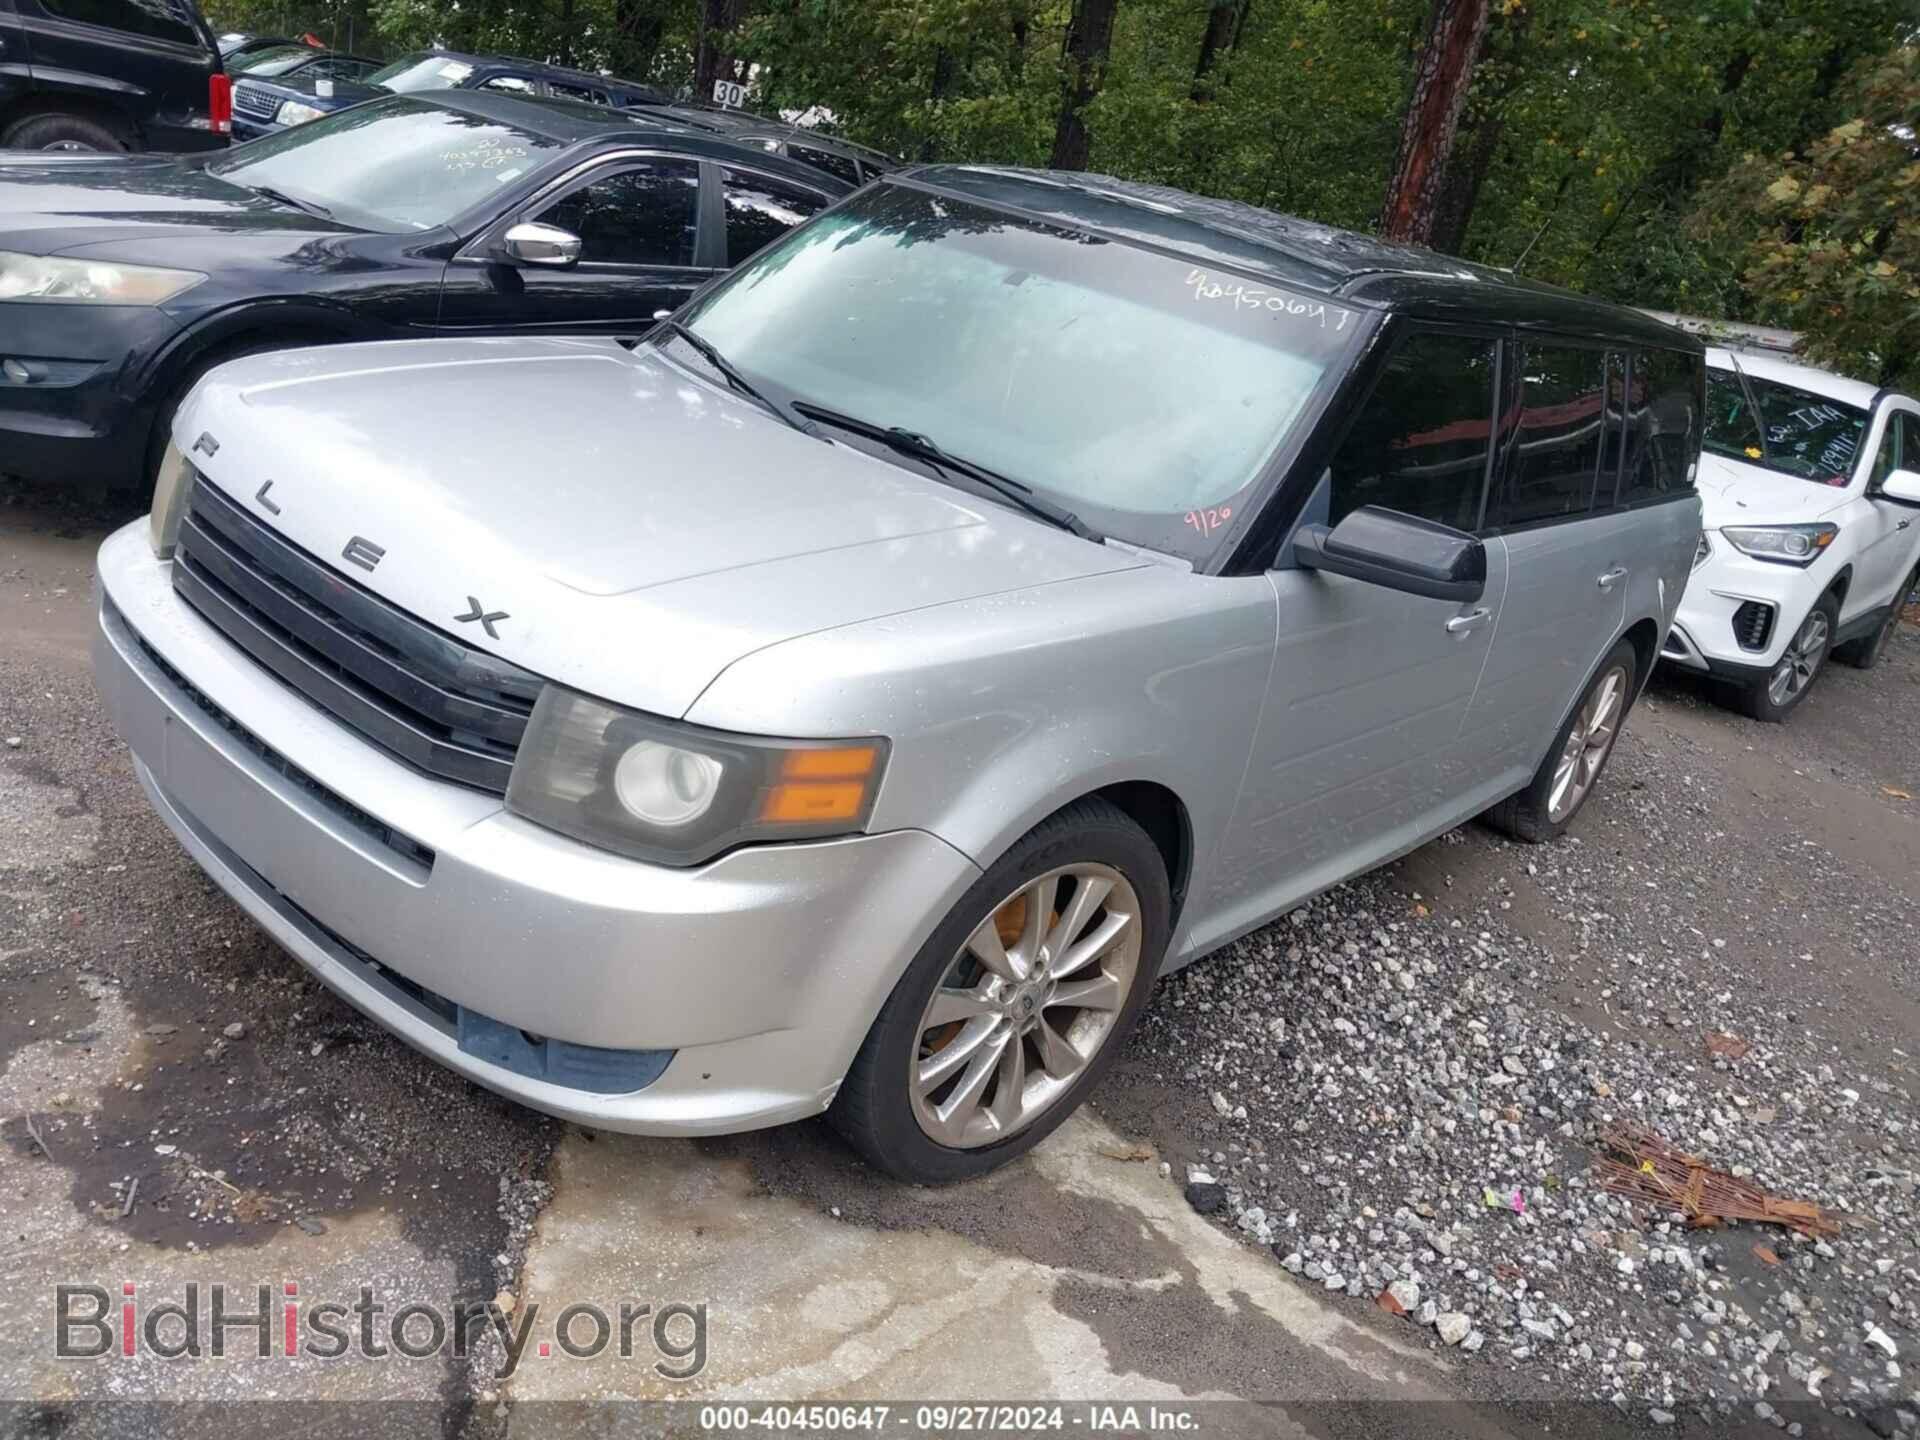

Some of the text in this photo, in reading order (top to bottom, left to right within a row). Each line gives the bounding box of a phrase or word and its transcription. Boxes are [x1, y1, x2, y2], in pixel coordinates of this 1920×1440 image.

[716, 82, 740, 104] 30
[1787, 404, 1848, 431] IAA
[191, 431, 511, 640] FLEX
